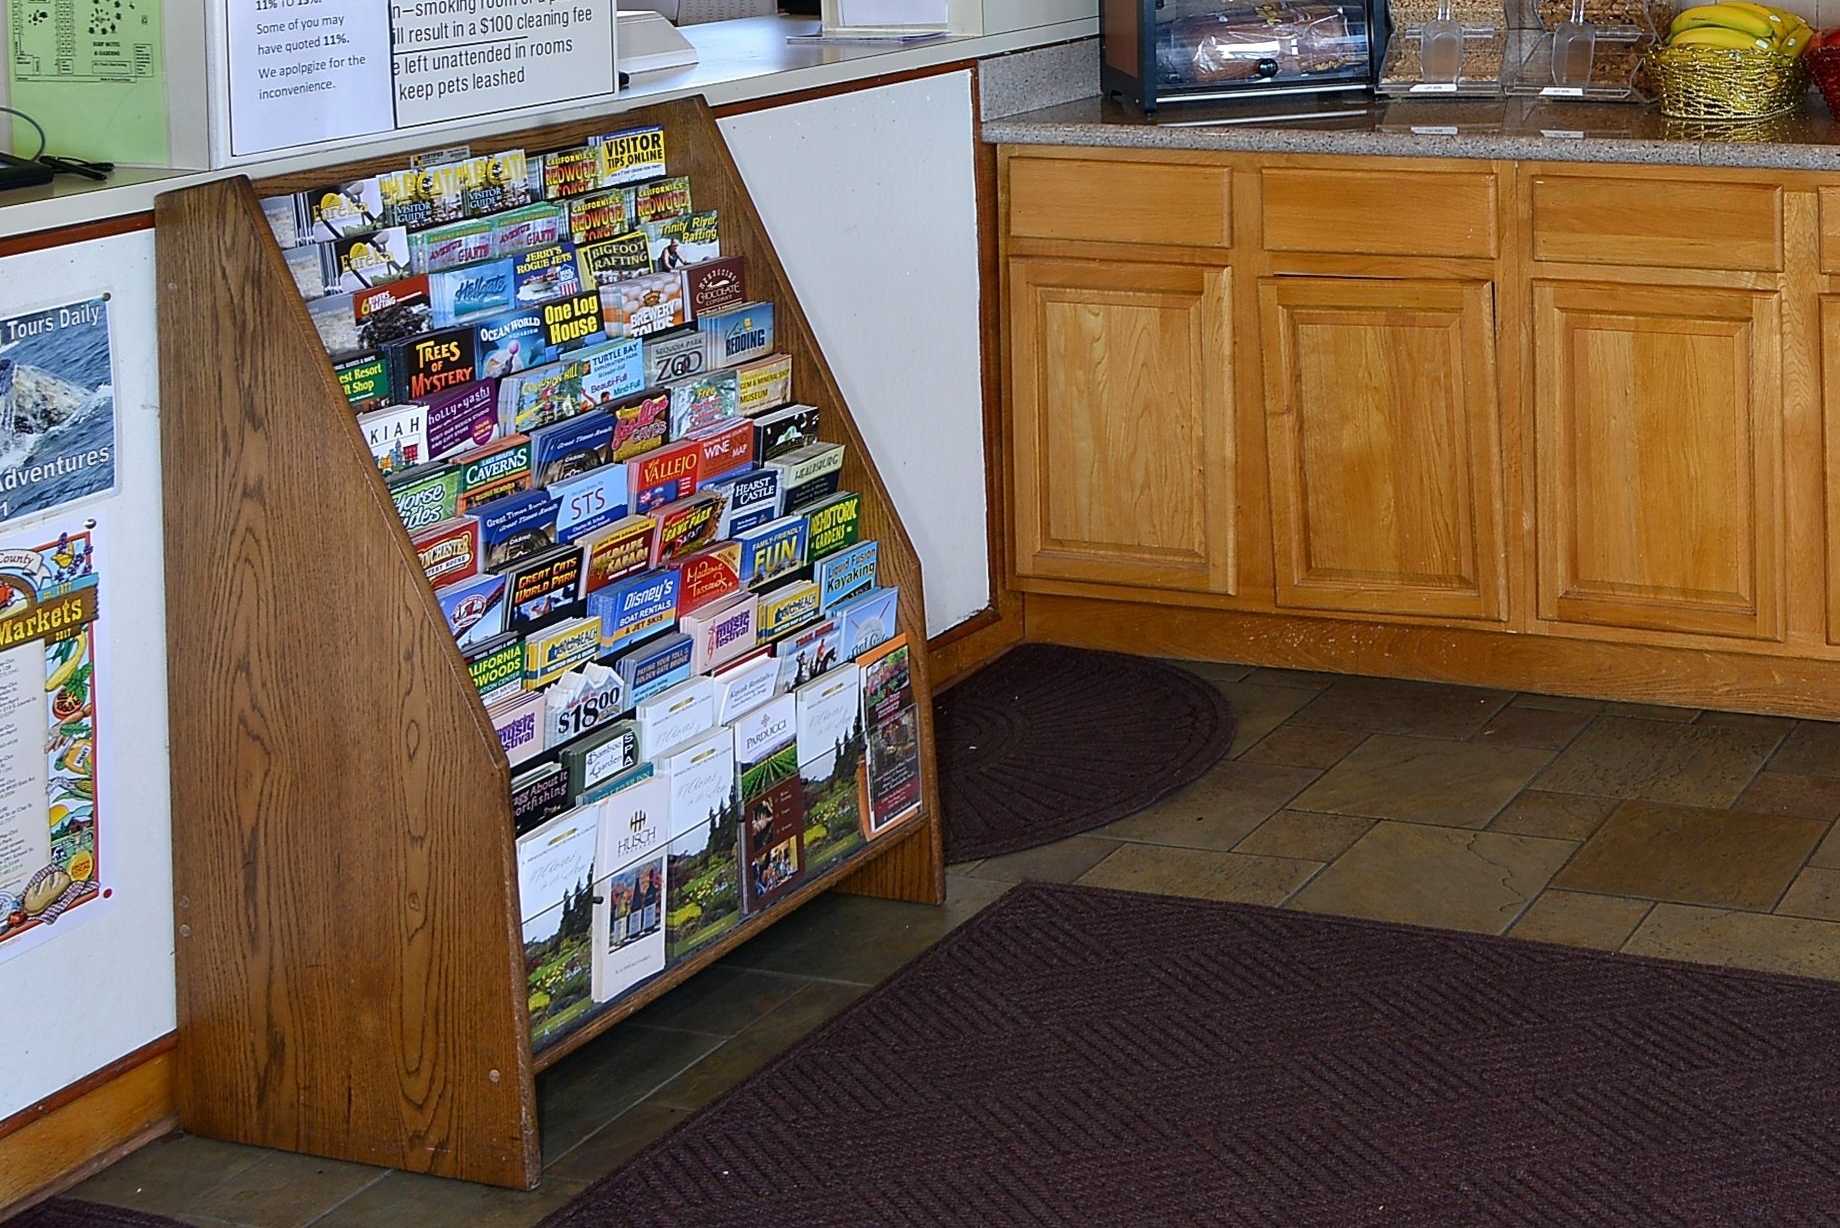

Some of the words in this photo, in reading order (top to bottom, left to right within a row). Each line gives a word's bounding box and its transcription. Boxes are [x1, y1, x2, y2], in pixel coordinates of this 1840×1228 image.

[256, 21, 286, 35] Some
[288, 18, 299, 31] of
[300, 18, 320, 32] you
[322, 15, 345, 28] may
[408, 21, 449, 43] result
[452, 21, 465, 38] in
[468, 22, 477, 36] a
[480, 15, 514, 36] $100
[516, 8, 570, 30] cleaning
[572, 6, 592, 22] fee
[257, 43, 283, 56] have
[285, 36, 321, 53] quoted
[323, 34, 350, 46] 11%.
[405, 54, 429, 74] left
[432, 45, 512, 70] unattended
[515, 41, 527, 58] in
[530, 39, 573, 57] rooms
[258, 67, 277, 79] We
[329, 57, 345, 69] for
[348, 55, 366, 66] the
[259, 80, 336, 100] inconvenience.
[399, 81, 434, 101] keep
[438, 75, 469, 98] pets
[472, 67, 525, 90] leashed
[606, 133, 662, 156] VISITOR
[608, 156, 624, 169] TIPS
[628, 149, 663, 165] ONLINE
[659, 220, 688, 236] Trinity
[692, 215, 718, 229] River
[682, 228, 718, 244] Rafting
[592, 239, 646, 259] BIGFOOT
[594, 252, 648, 270] RAFTING
[544, 304, 571, 325] One
[575, 294, 598, 316] Log
[630, 302, 676, 326] BREWERY
[8, 316, 54, 341] Tours
[59, 305, 100, 329] Daily
[550, 316, 598, 345] House
[726, 331, 765, 357] REDDING
[644, 453, 697, 483] VALLEJO
[735, 477, 771, 498] HEARST
[740, 485, 776, 505] CASTLE
[754, 536, 798, 571] FUN
[515, 581, 550, 604] WORLD
[551, 569, 577, 589] PARK
[518, 568, 551, 590] GREAT
[624, 578, 673, 611] Disney's
[746, 719, 788, 749] PARDUCCI
[618, 827, 656, 854] HUSCH
